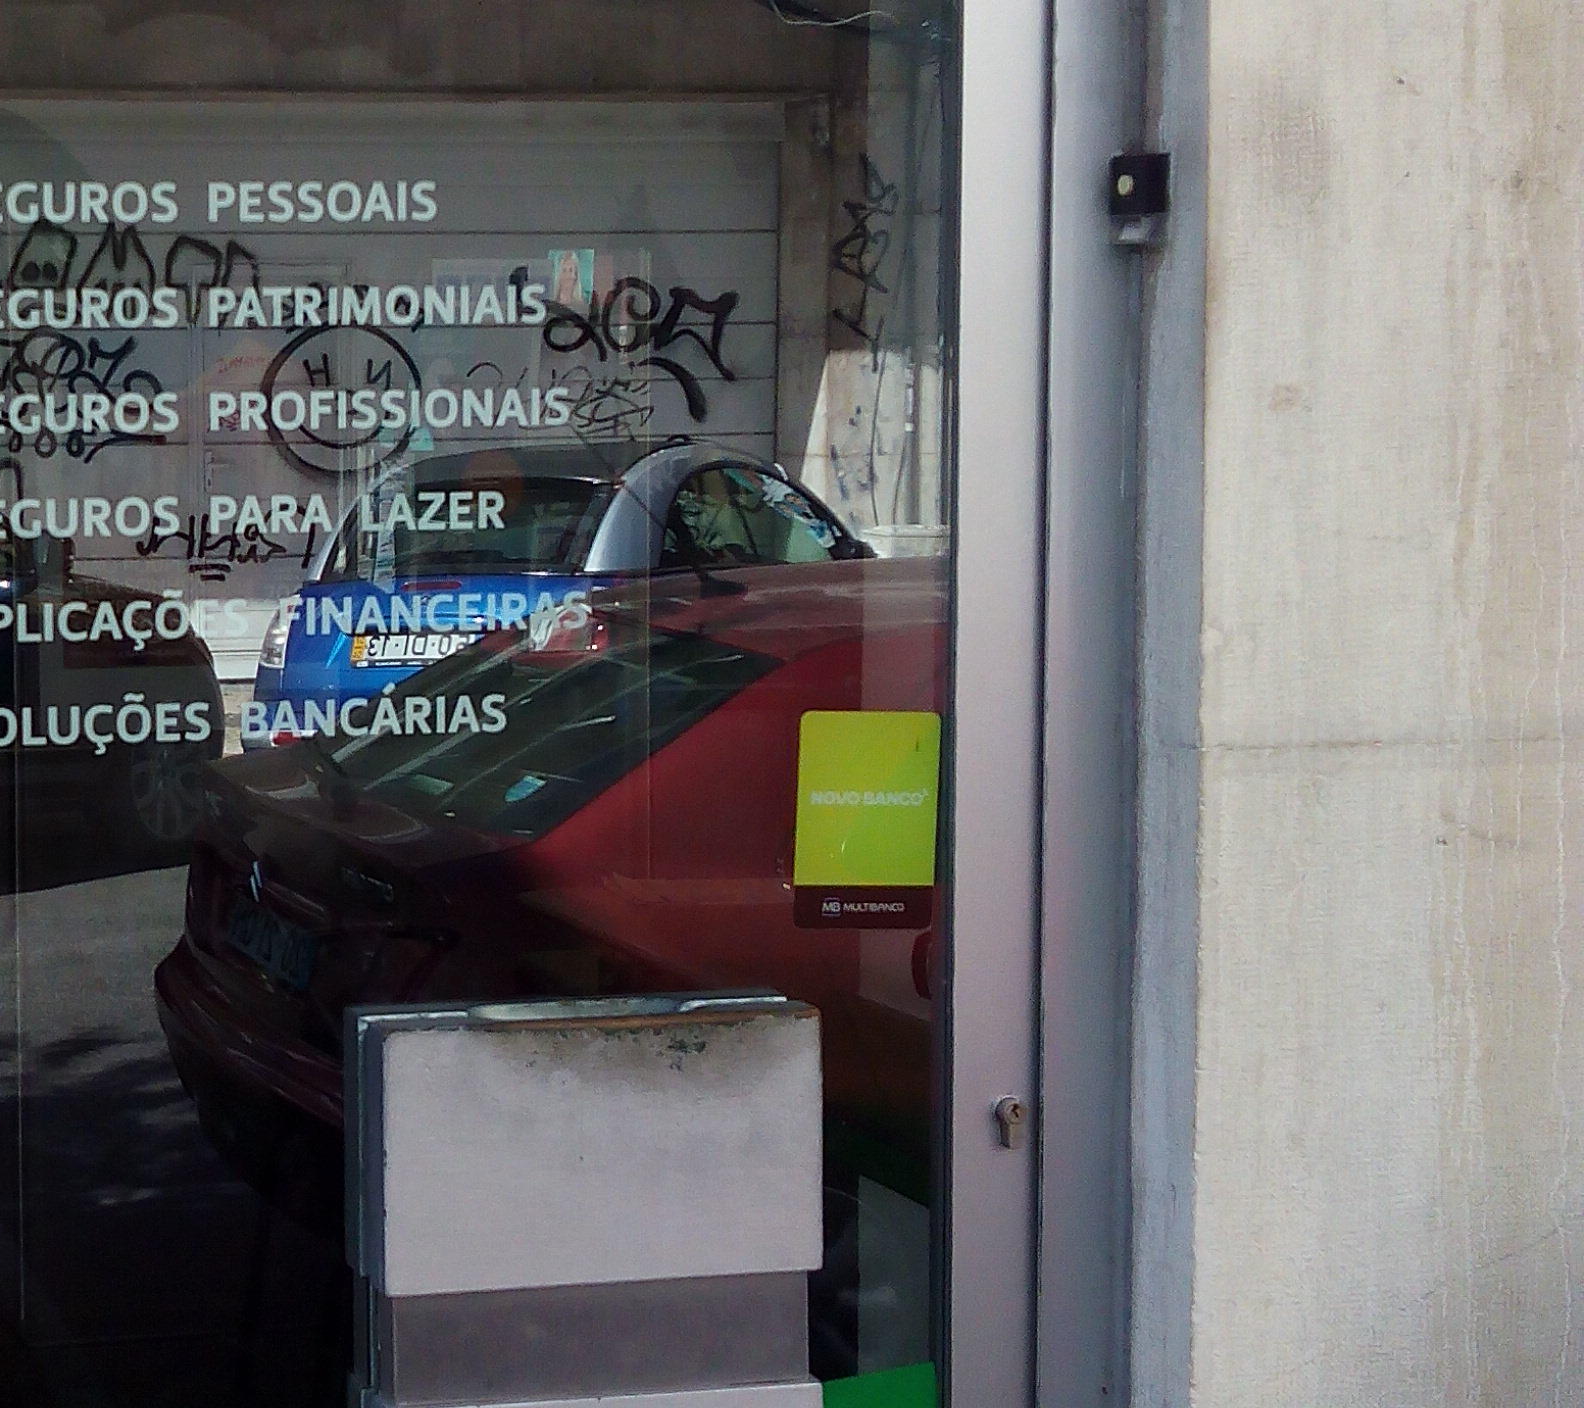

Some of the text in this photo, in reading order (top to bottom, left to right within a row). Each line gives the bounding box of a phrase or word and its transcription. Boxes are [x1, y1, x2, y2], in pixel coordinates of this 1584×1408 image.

[208, 180, 438, 224] PESSOAIS
[208, 284, 547, 330] PATRIMONIAIS
[209, 388, 571, 432] PROFISSIONAIS
[210, 495, 333, 534] PARA
[360, 491, 506, 532] LAZER
[288, 591, 589, 636] FINANCEIRAS
[241, 684, 508, 738] BANCÁRIAS
